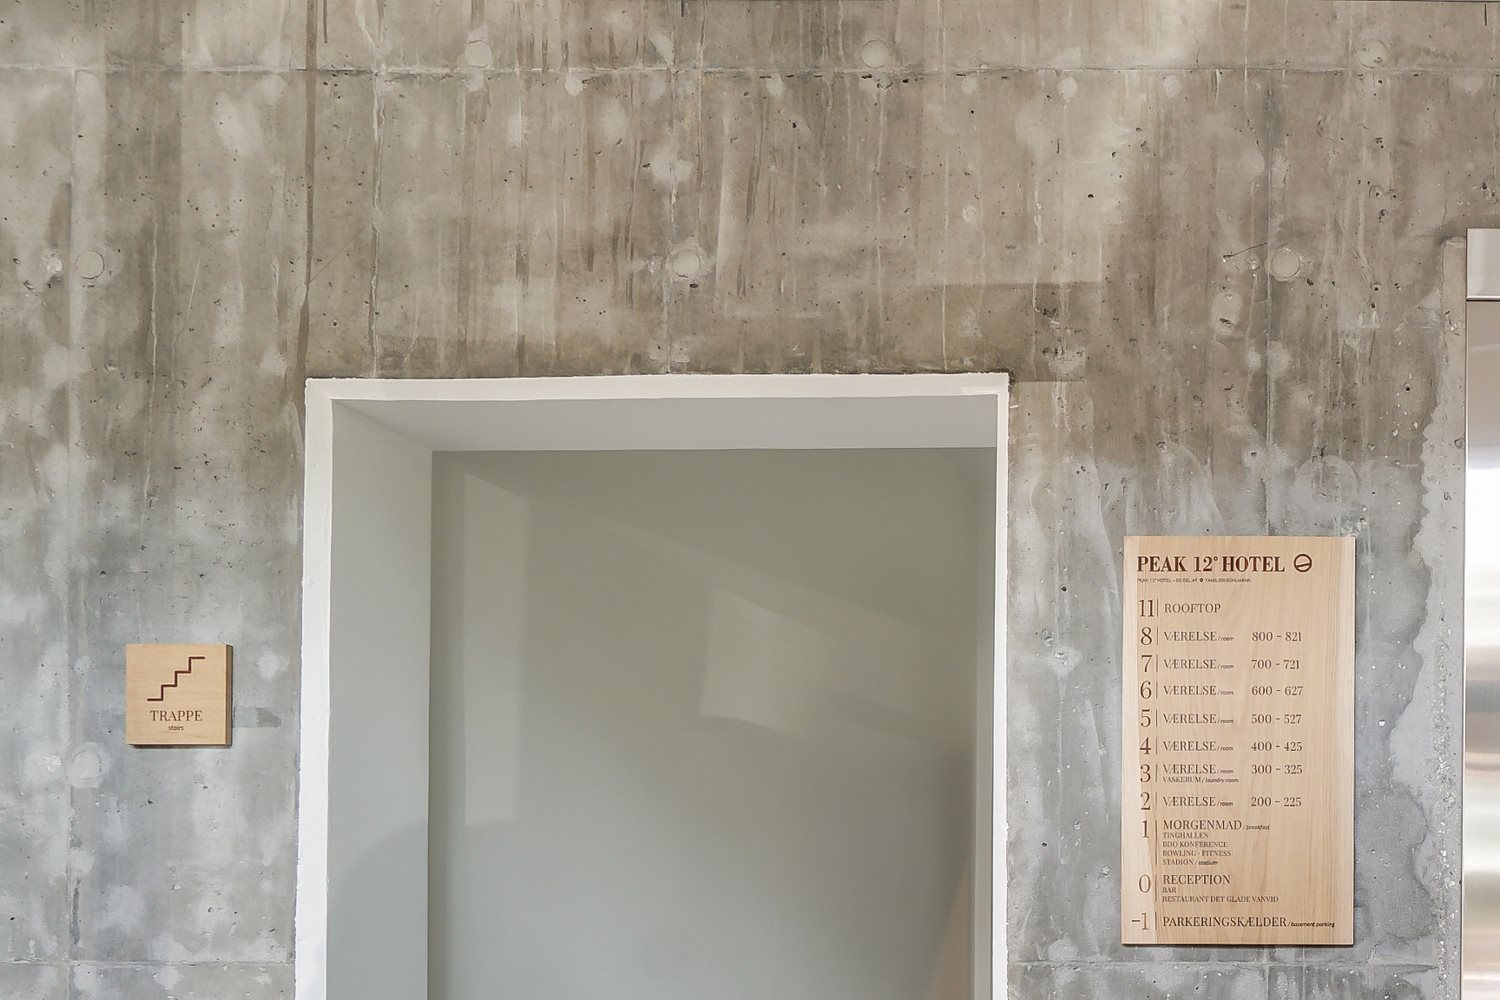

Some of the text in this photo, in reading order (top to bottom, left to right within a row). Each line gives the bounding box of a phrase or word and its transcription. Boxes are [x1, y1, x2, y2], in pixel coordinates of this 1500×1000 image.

[1137, 556, 1285, 573] PEAK 12° HOTEL
[1139, 599, 1221, 617] 11 ROOFTOP
[1140, 627, 1152, 645] 8
[1164, 631, 1217, 642] VÆRELSE
[1251, 631, 1273, 642] 800
[1285, 631, 1302, 642] 821
[1141, 655, 1152, 673] 7
[1164, 659, 1216, 669] VÆRELSE
[1251, 659, 1272, 669] 700
[1283, 659, 1300, 669] 721
[1140, 681, 1152, 699] 6
[1163, 685, 1216, 696] VÆRELSE
[1251, 685, 1273, 696] 600
[1284, 685, 1303, 696] 627
[150, 710, 202, 721] TRAPPE
[1140, 709, 1151, 728] 5
[1163, 714, 1216, 724] VÆRELSE
[1251, 714, 1273, 724] 500
[1283, 714, 1302, 724] 527
[1140, 737, 1152, 755] 4
[1163, 741, 1216, 751] VÆRELSE
[1251, 741, 1273, 752] 400
[1284, 741, 1303, 752] 425
[1140, 764, 1152, 782] 3
[1163, 764, 1216, 774] VÆRELSE
[1251, 764, 1273, 775] 300
[1284, 764, 1303, 775] 325
[1140, 792, 1151, 810] 2
[1163, 797, 1216, 807] VÆRELSE
[1251, 797, 1271, 807] 200
[1283, 797, 1302, 807] 225
[1142, 820, 1148, 838] 1
[1163, 820, 1242, 830] MORGENMAD
[1139, 874, 1231, 893] 0 RECEPTION
[1163, 917, 1286, 927] PARKERINGSKÆLDER
